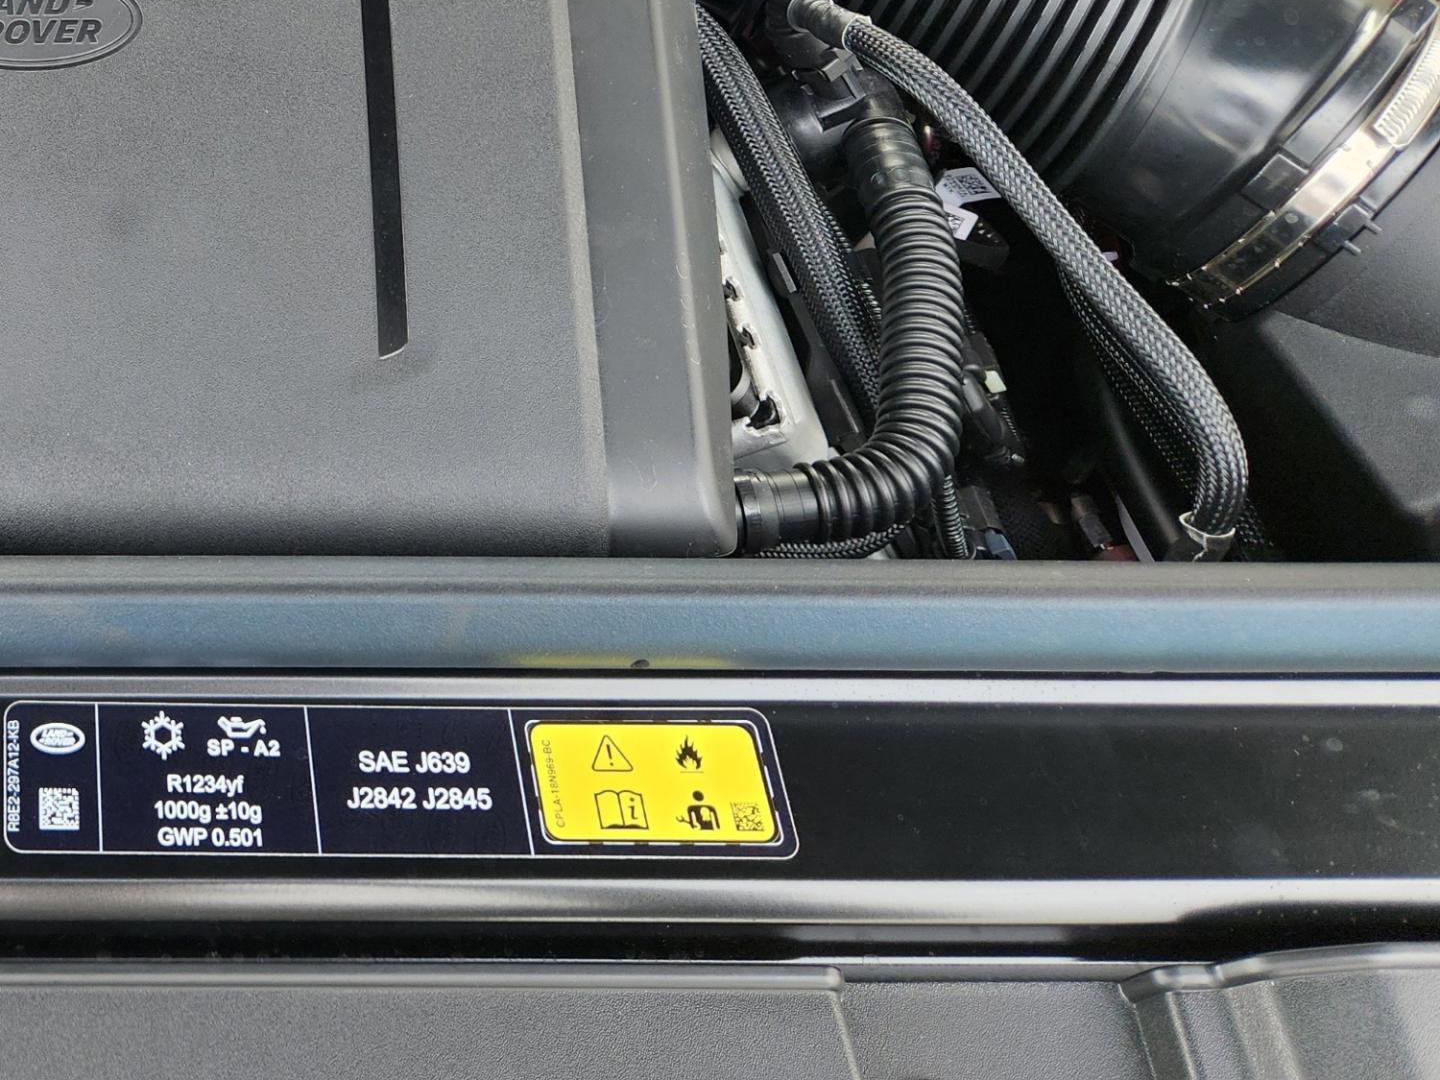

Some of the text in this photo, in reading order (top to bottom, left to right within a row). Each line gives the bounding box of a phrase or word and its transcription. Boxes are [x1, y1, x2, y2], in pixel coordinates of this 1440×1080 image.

[207, 739, 235, 757] SP
[254, 739, 281, 757] A2
[358, 750, 471, 774] SAE J639
[166, 774, 244, 797] R1234yf
[347, 787, 493, 811] J2842 J2845
[154, 800, 211, 824] 1000g
[157, 827, 263, 847] GWP 0.501
